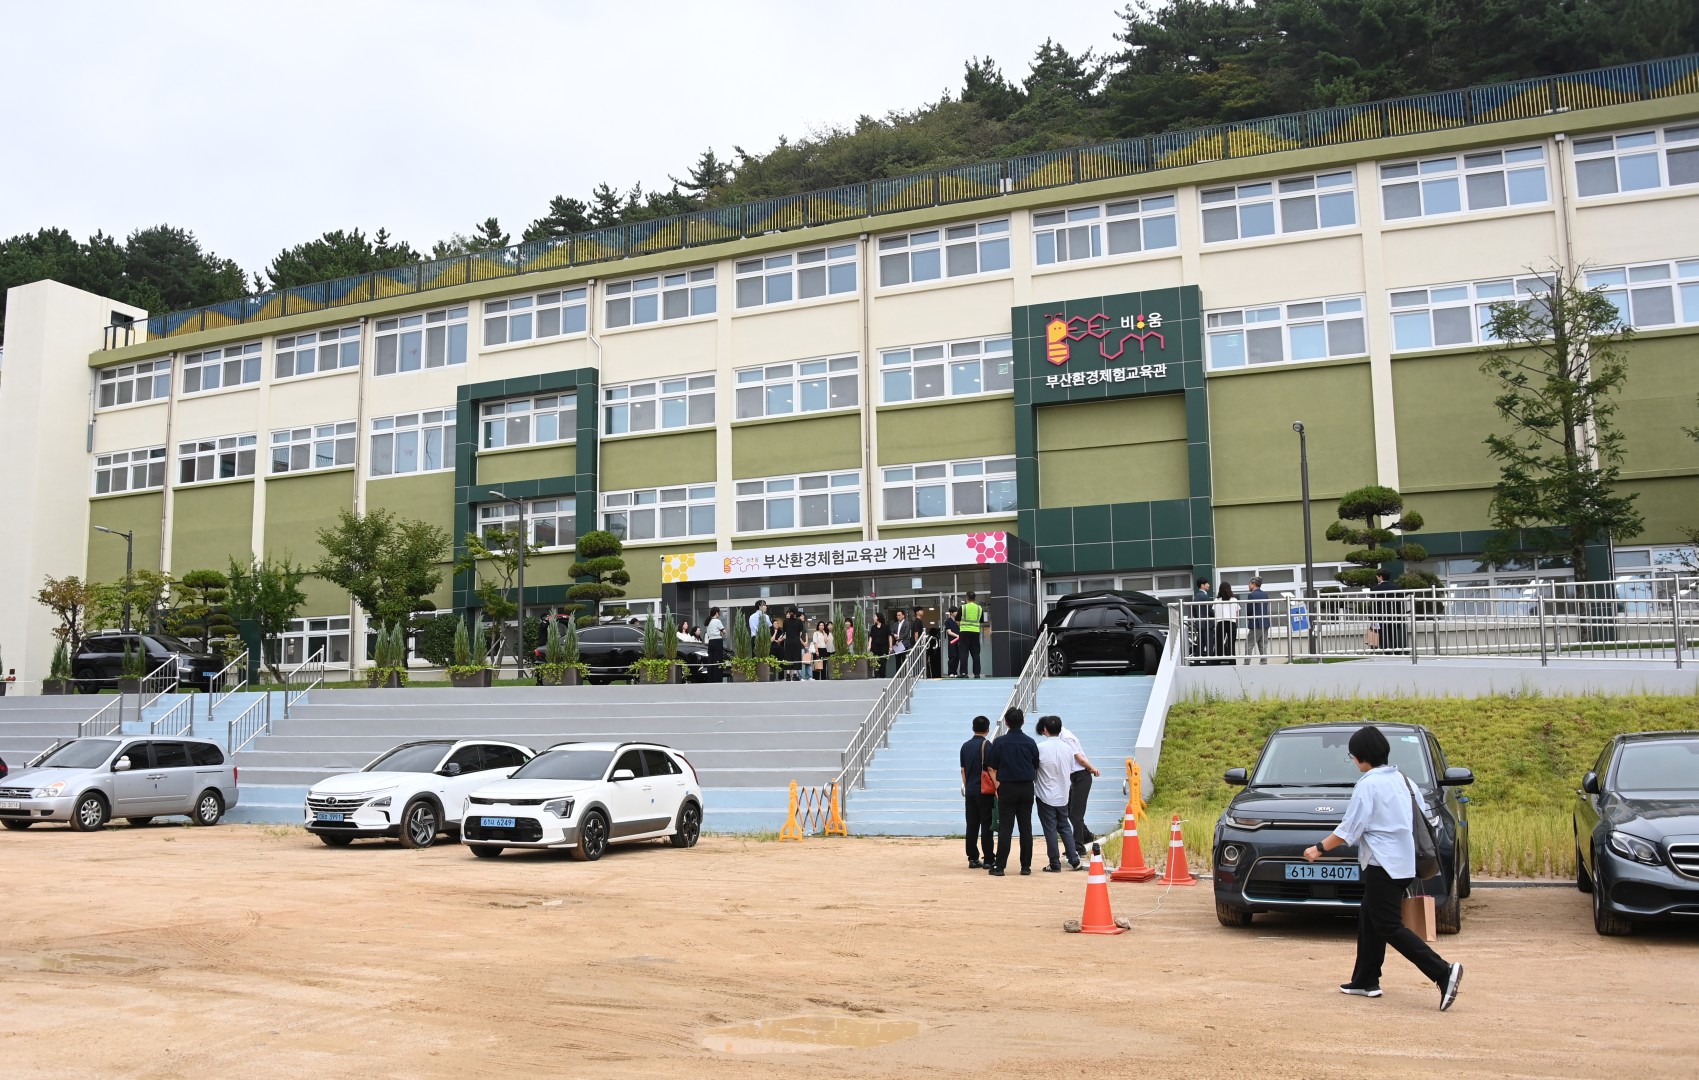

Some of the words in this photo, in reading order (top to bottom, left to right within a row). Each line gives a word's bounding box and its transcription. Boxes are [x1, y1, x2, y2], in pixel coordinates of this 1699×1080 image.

[1046, 363, 1168, 389] 부산환경체험교육관
[763, 546, 888, 570] 부산환경체험교육관
[892, 543, 936, 561] 개관식
[496, 818, 512, 827] 6249
[1291, 866, 1315, 878] 61가
[1321, 866, 1353, 879] 8407
